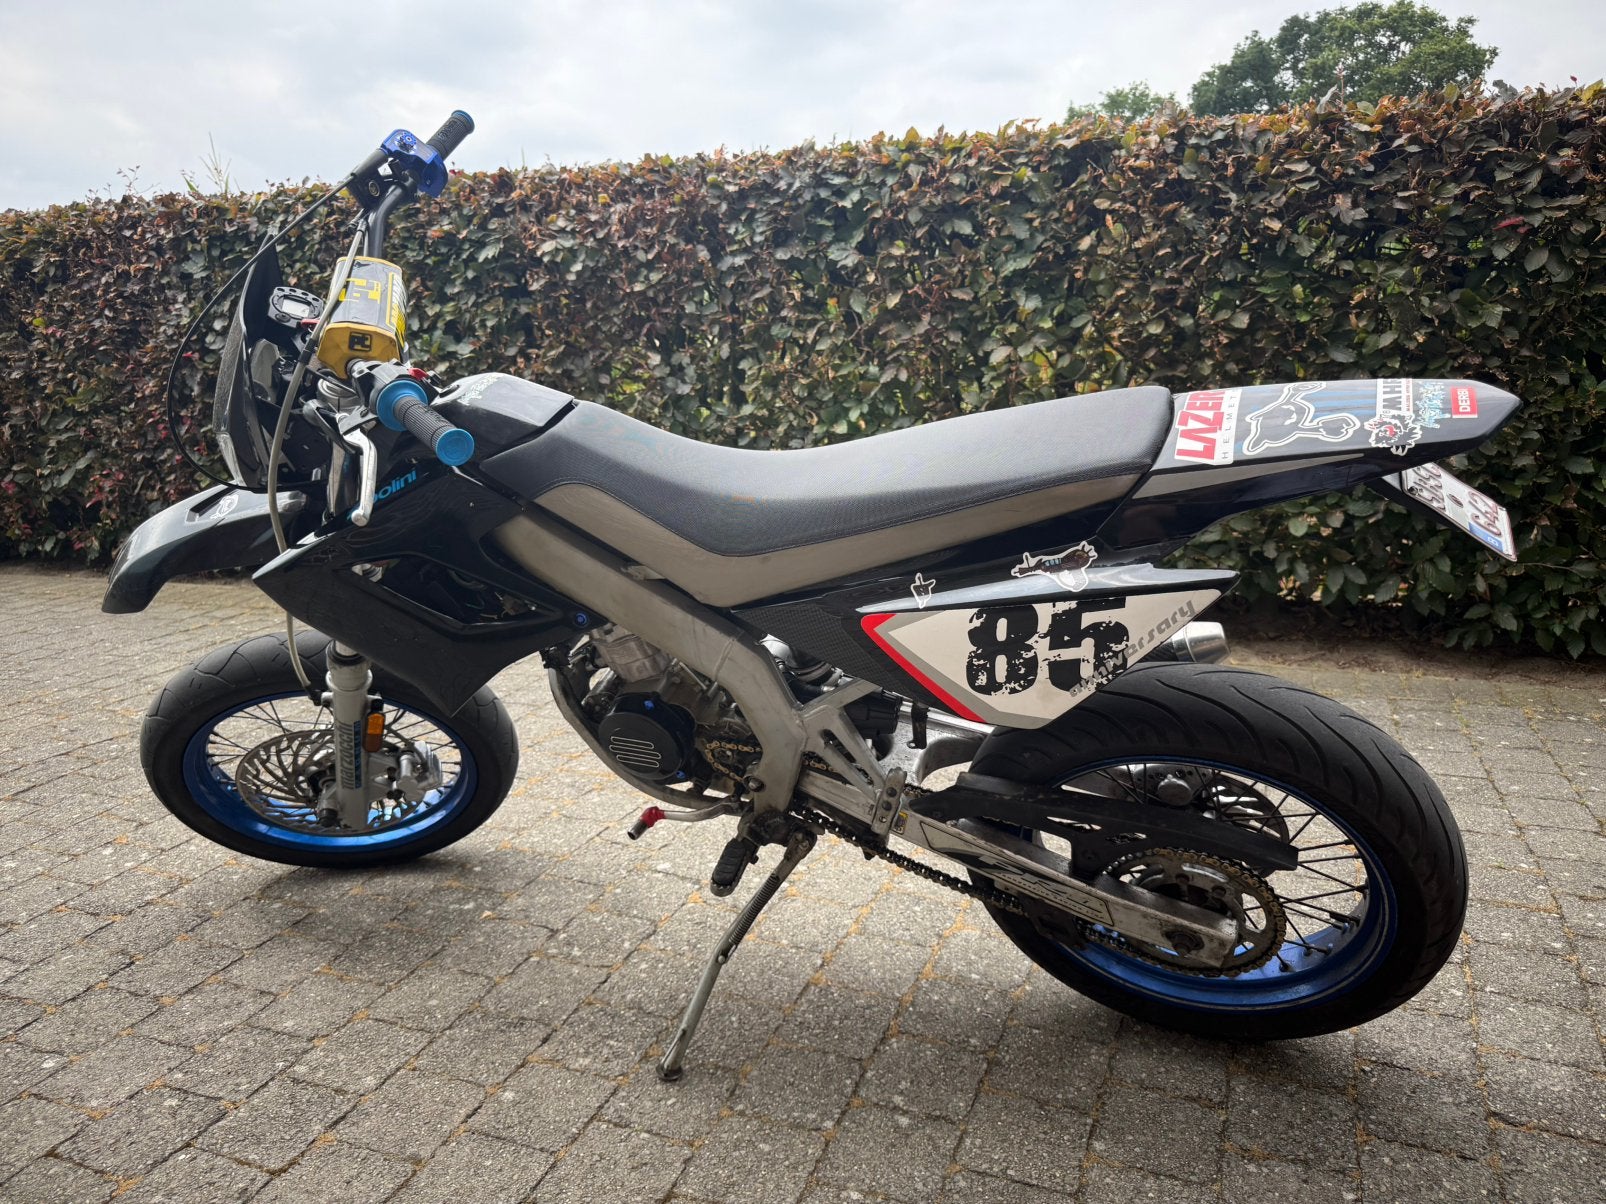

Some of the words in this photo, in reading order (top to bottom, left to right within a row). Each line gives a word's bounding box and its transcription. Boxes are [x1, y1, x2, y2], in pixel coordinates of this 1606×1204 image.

[1176, 390, 1225, 460] LAZER
[966, 597, 1130, 696] 85
[1069, 600, 1197, 697] anniversary
